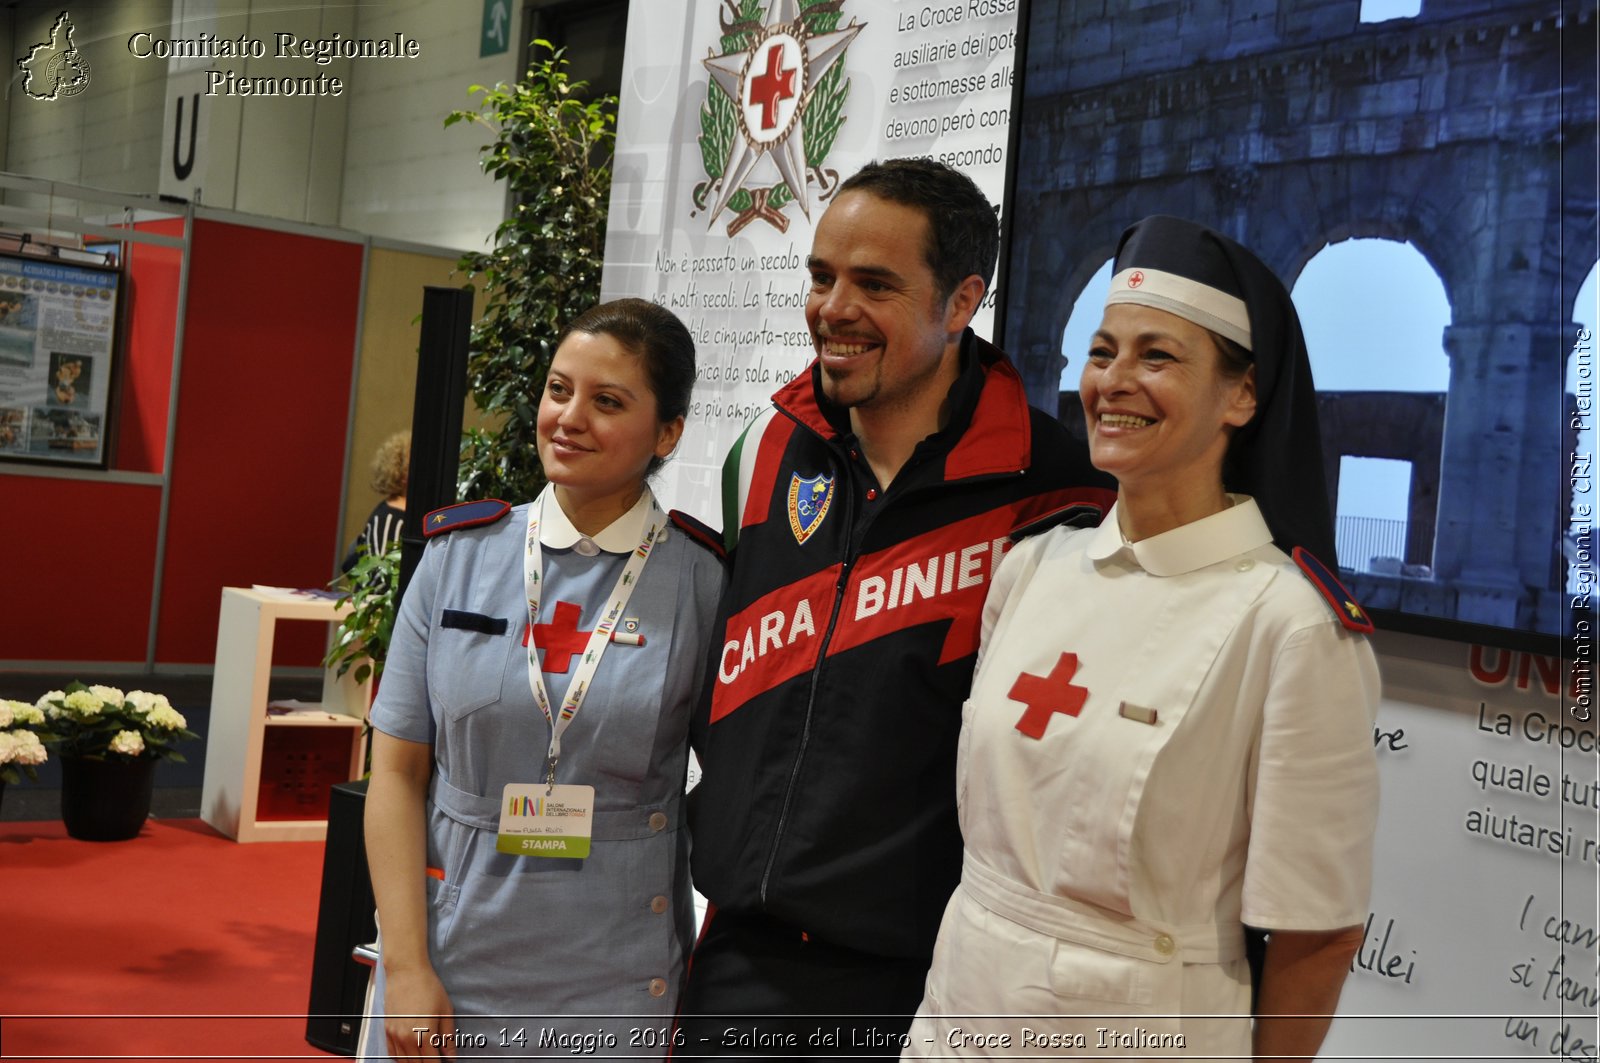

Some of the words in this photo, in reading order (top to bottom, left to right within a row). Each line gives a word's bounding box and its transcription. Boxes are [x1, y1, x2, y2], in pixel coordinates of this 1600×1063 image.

[898, 12, 915, 32] La
[920, 4, 963, 28] Croce
[968, 0, 1016, 19] Rossa
[894, 40, 956, 68] ausiliarie
[961, 33, 984, 55] dei
[890, 88, 899, 103] e
[902, 75, 986, 102] sottomesse
[173, 93, 199, 181] U
[886, 118, 937, 139] devono
[941, 108, 975, 137] però
[980, 108, 1011, 128] con
[939, 144, 1003, 167] secondo
[655, 250, 677, 273] Non
[681, 253, 687, 273] è
[692, 245, 736, 280] passato
[741, 257, 755, 270] un
[760, 241, 799, 270] secolo
[671, 282, 699, 308] molti
[703, 281, 738, 308] secoli.
[743, 281, 759, 308] La
[725, 355, 739, 382] da
[745, 355, 769, 383] sola
[705, 397, 721, 425] più
[718, 599, 816, 684] CARA
[1479, 702, 1512, 736] La
[1472, 760, 1551, 796] quale
[522, 839, 567, 850] STAMPA
[1466, 807, 1573, 856] aiutarsi
[1350, 912, 1416, 984] lilei
[1510, 957, 1536, 988] si
[1505, 1017, 1538, 1047] un
